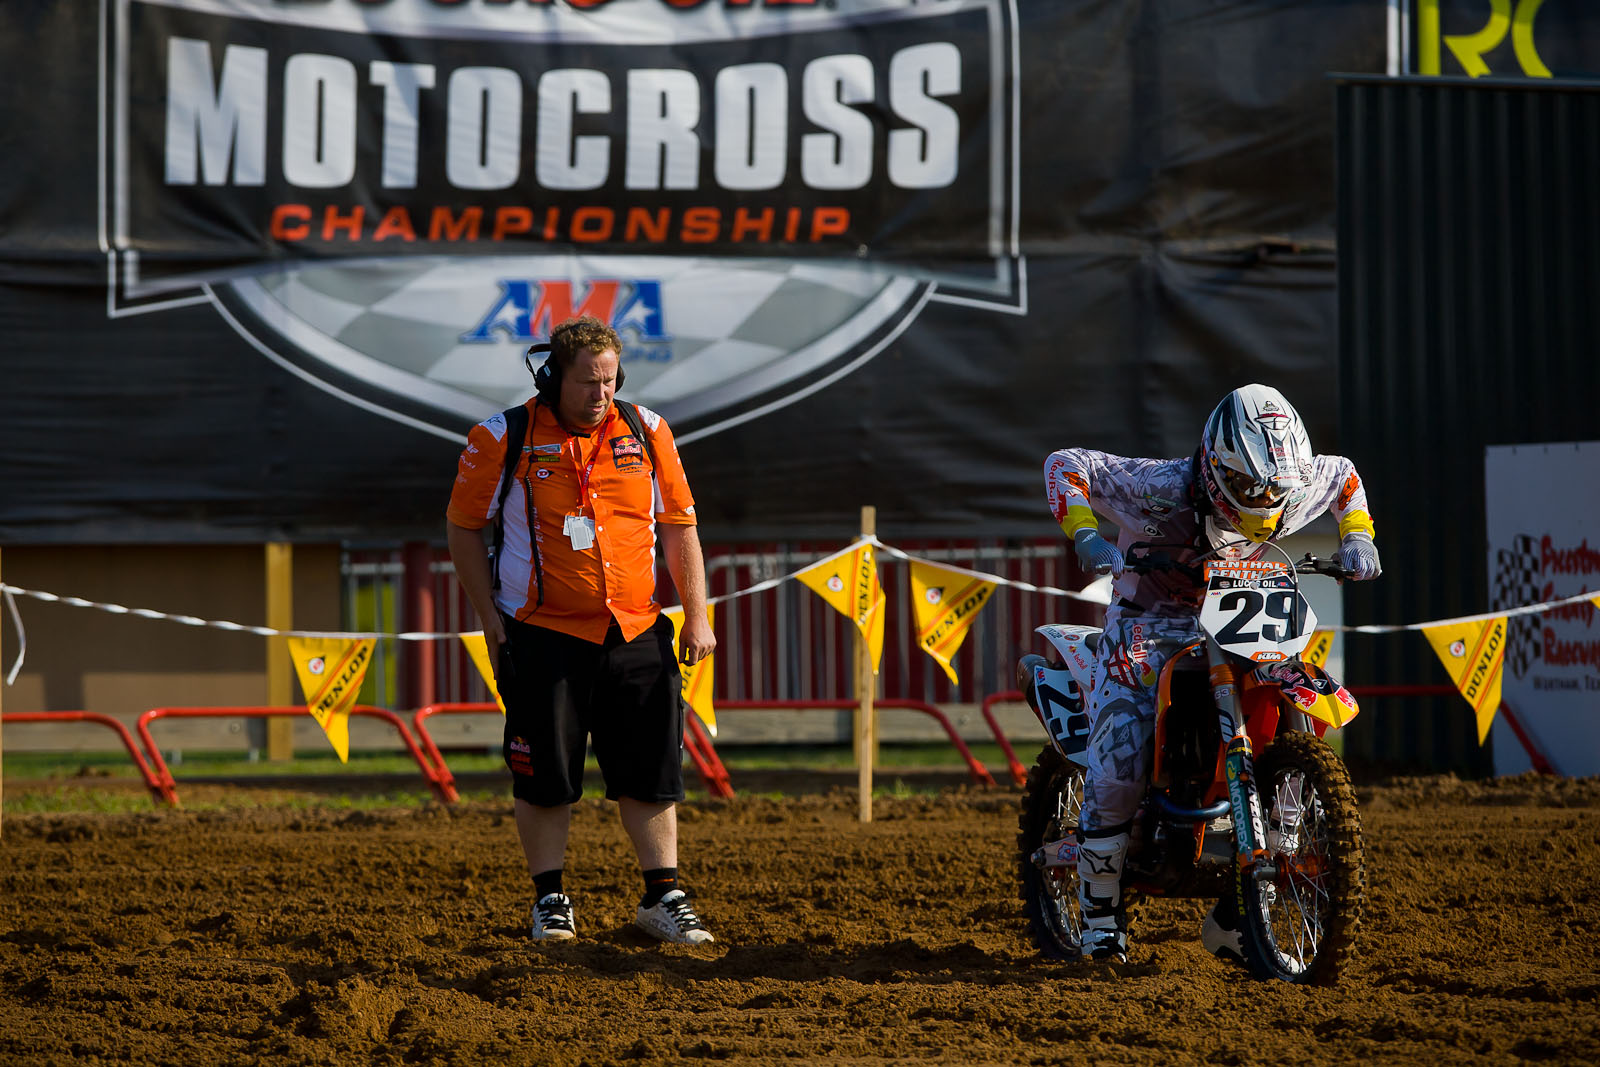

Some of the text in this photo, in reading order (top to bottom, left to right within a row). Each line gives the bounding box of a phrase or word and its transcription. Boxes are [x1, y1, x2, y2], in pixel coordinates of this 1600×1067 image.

[165, 37, 962, 191] MOTOCROSS
[270, 204, 851, 243] CHAMPIONSHIP
[1207, 561, 1286, 570] RENTHAL
[1233, 579, 1277, 588] LUCS OIL
[925, 586, 988, 647] DUNLOP
[1214, 590, 1308, 645] 29
[1257, 651, 1282, 660] KTM
[1466, 623, 1503, 699] DUNLOP
[1230, 781, 1249, 851] MOTOREX
